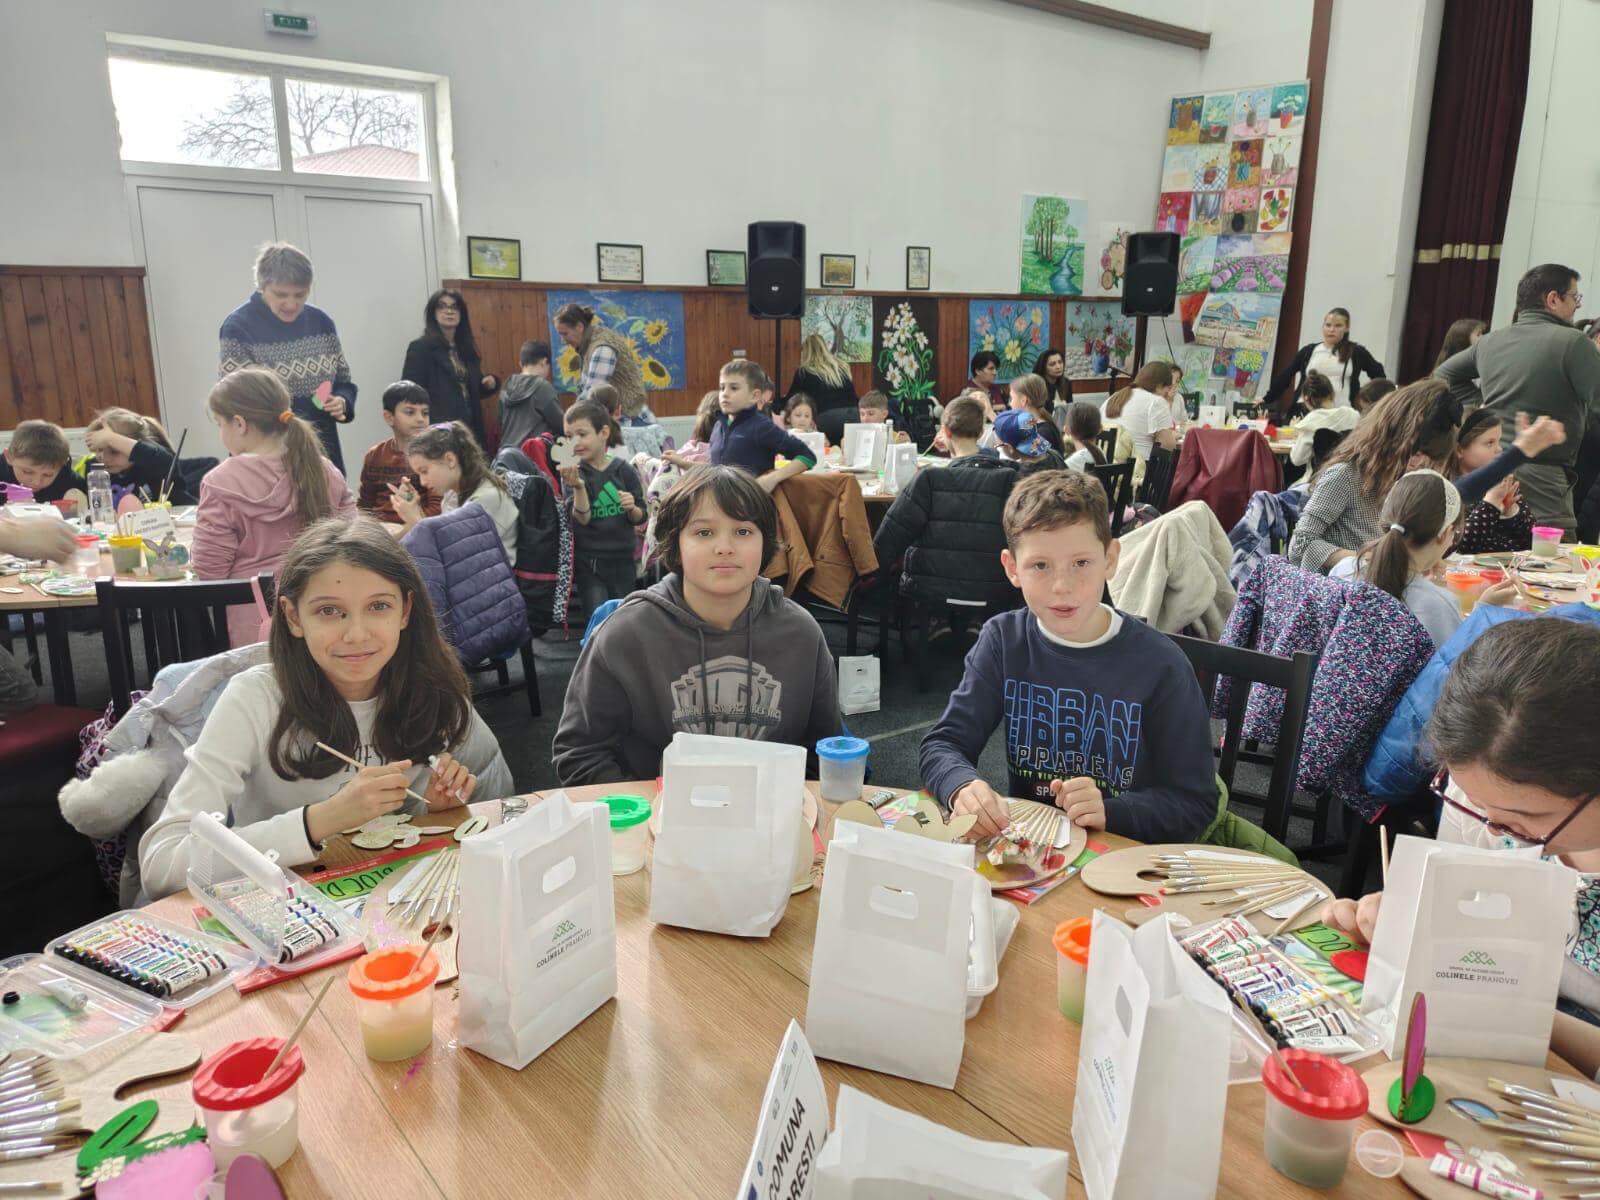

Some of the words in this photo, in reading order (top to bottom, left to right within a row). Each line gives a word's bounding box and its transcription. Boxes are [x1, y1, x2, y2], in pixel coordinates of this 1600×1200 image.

[1435, 971, 1476, 981] COLINELE
[1477, 975, 1519, 985] PRAHOVEI
[769, 1097, 806, 1200] COMUNA
